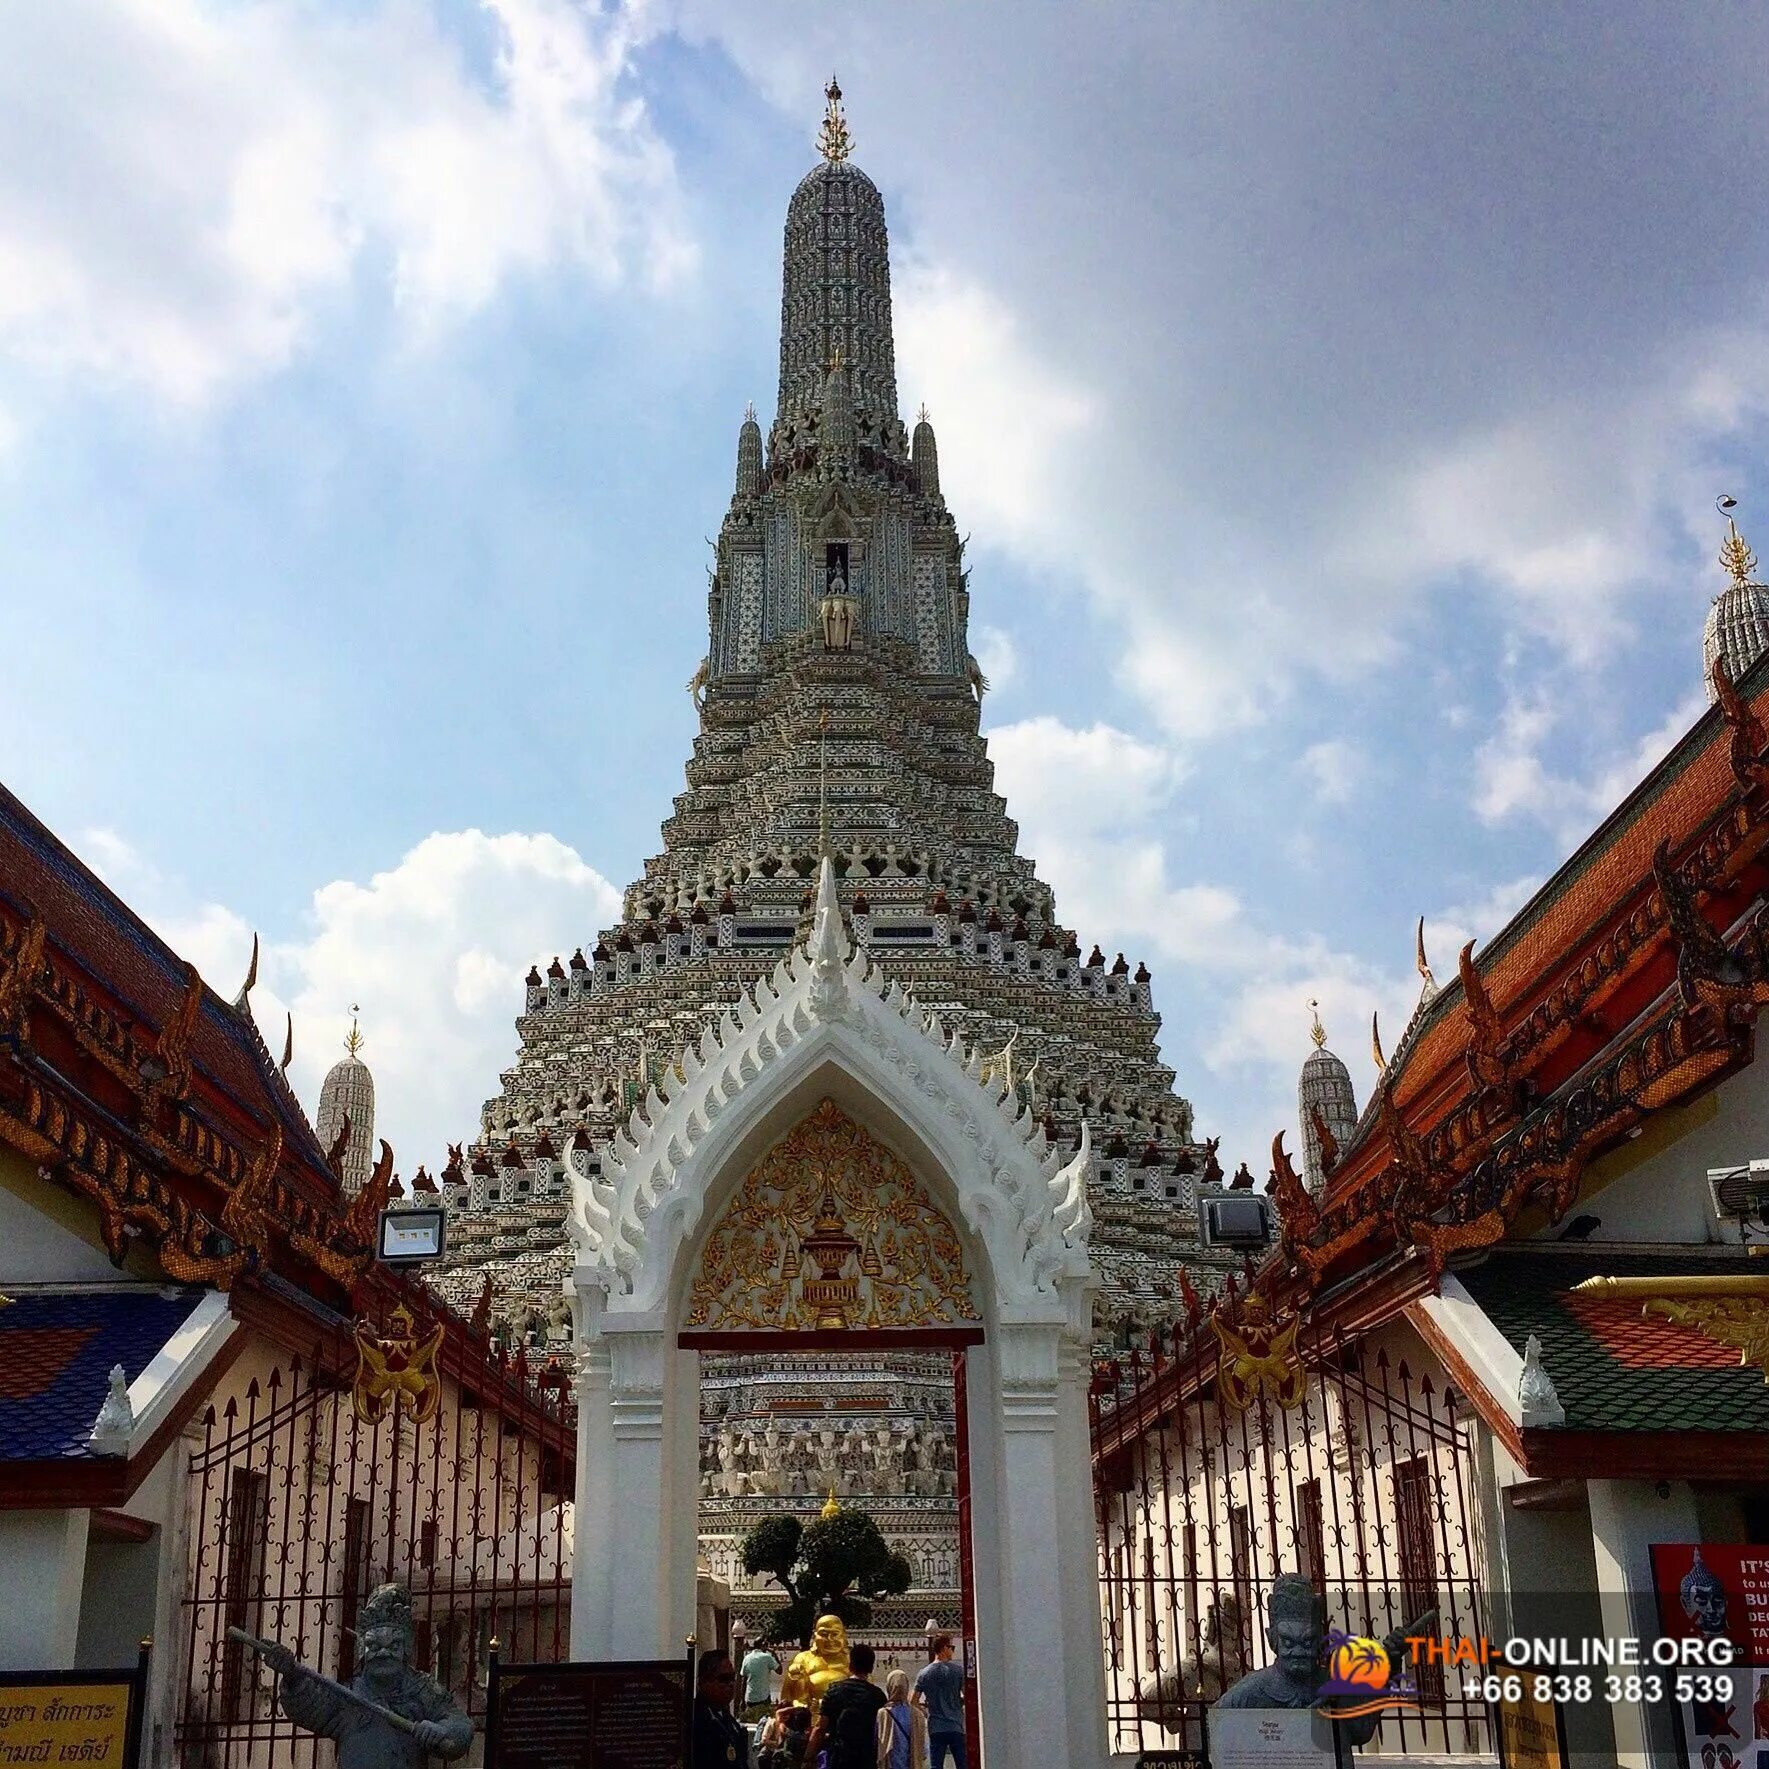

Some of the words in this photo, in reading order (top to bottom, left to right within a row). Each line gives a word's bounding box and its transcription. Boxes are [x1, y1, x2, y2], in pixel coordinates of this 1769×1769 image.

[1742, 1579, 1756, 1589] to
[1745, 1593, 1769, 1606] BU
[1749, 1627, 1769, 1638] TA
[0, 1738, 54, 1762] ามณี
